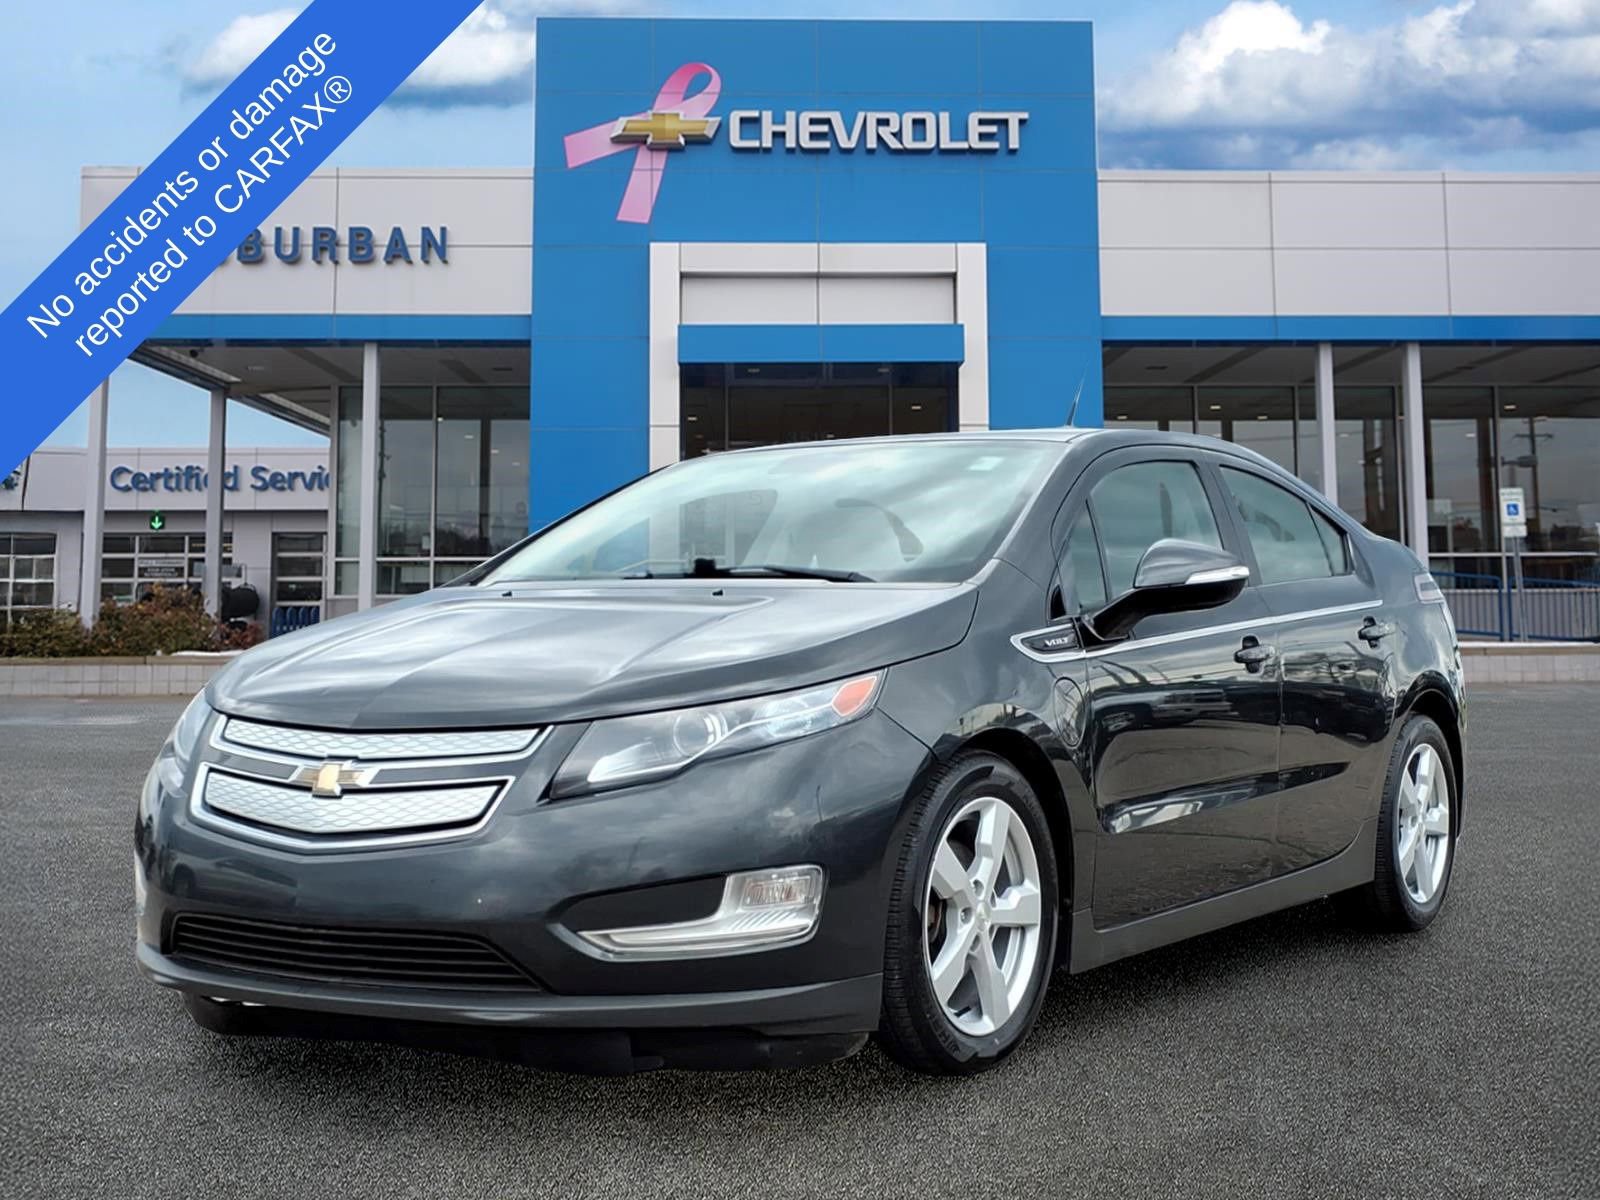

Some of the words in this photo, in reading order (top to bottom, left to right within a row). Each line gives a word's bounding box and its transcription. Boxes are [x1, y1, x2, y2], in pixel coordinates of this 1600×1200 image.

[729, 110, 1029, 151] CHEVROLET
[221, 226, 448, 264] BURBAN
[110, 465, 240, 492] Certifid
[250, 465, 329, 491] Servi
